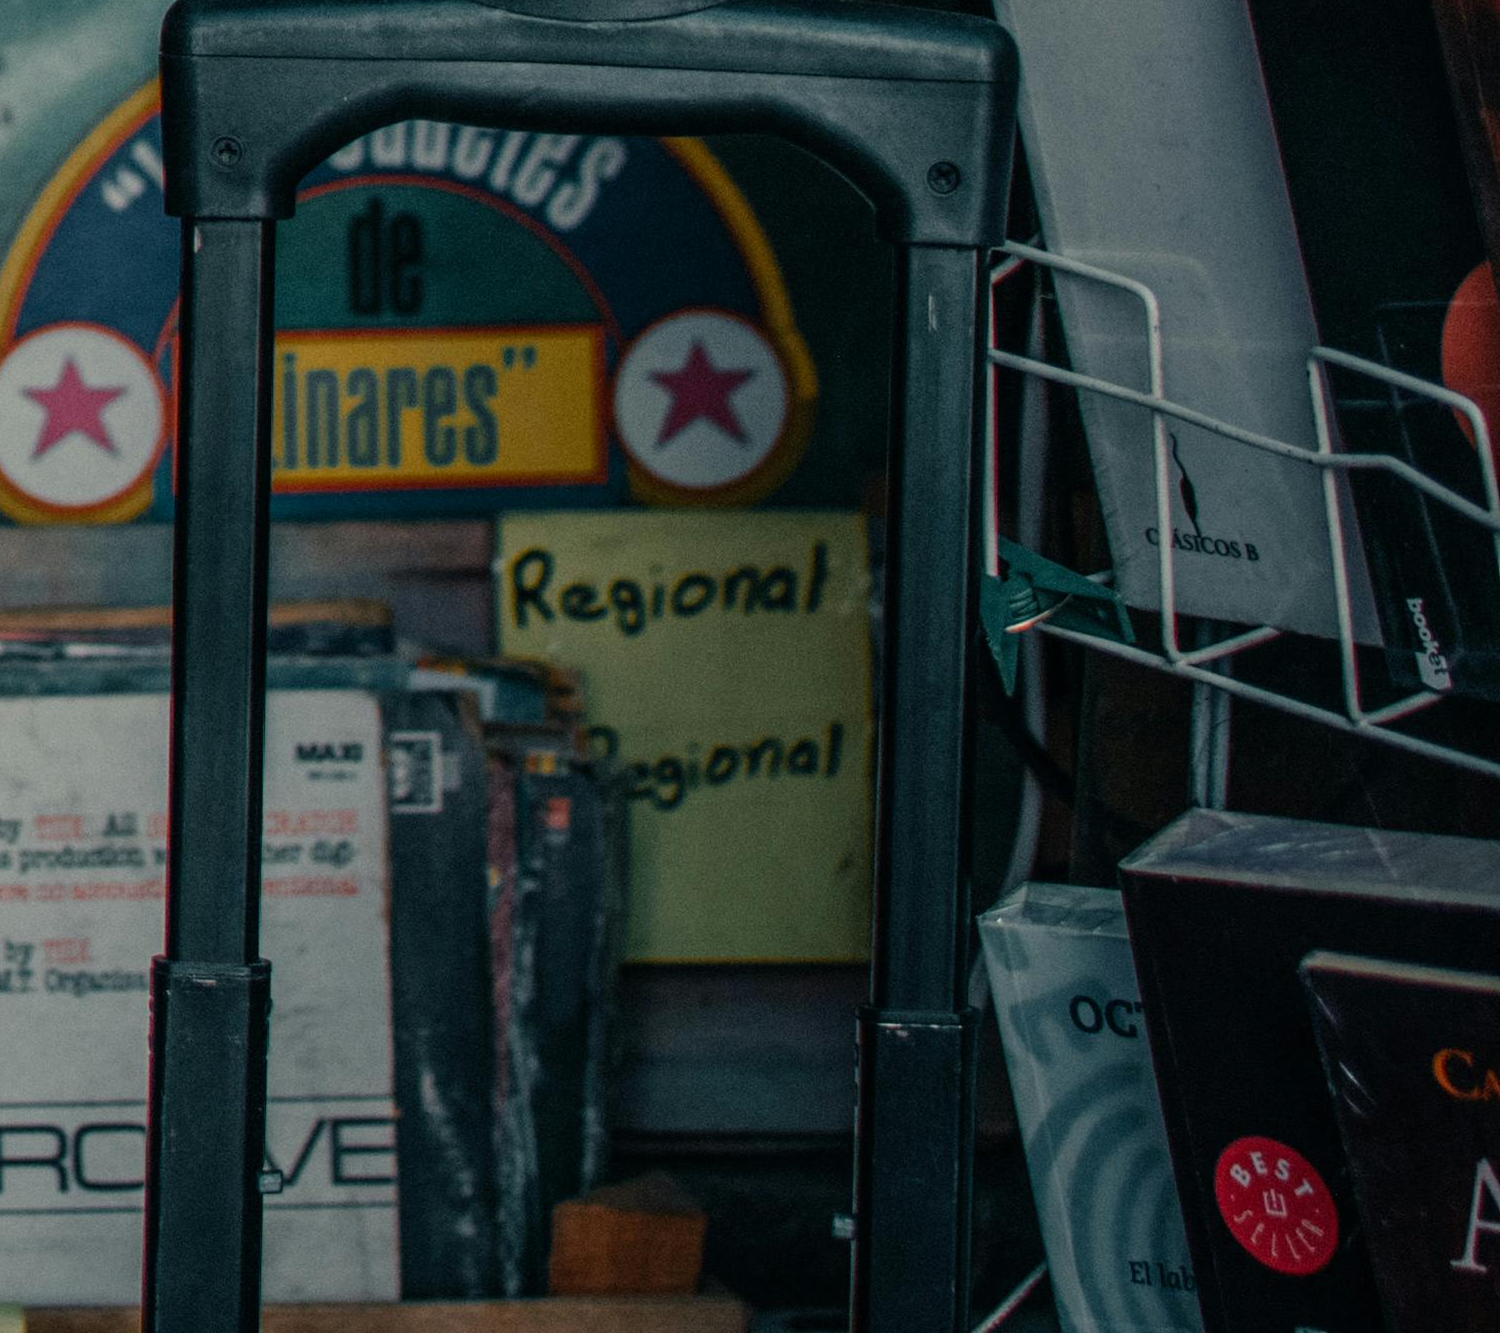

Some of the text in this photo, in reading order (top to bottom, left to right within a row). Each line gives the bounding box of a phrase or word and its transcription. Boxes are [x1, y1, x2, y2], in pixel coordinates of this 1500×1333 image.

[348, 197, 423, 318] de
[1145, 527, 1259, 561] CÁSICOS B
[510, 540, 828, 637] Regional
[1405, 597, 1450, 675] booket
[4, 939, 35, 965] by
[1229, 1150, 1314, 1198] BEST
[1129, 1260, 1156, 1287] El
